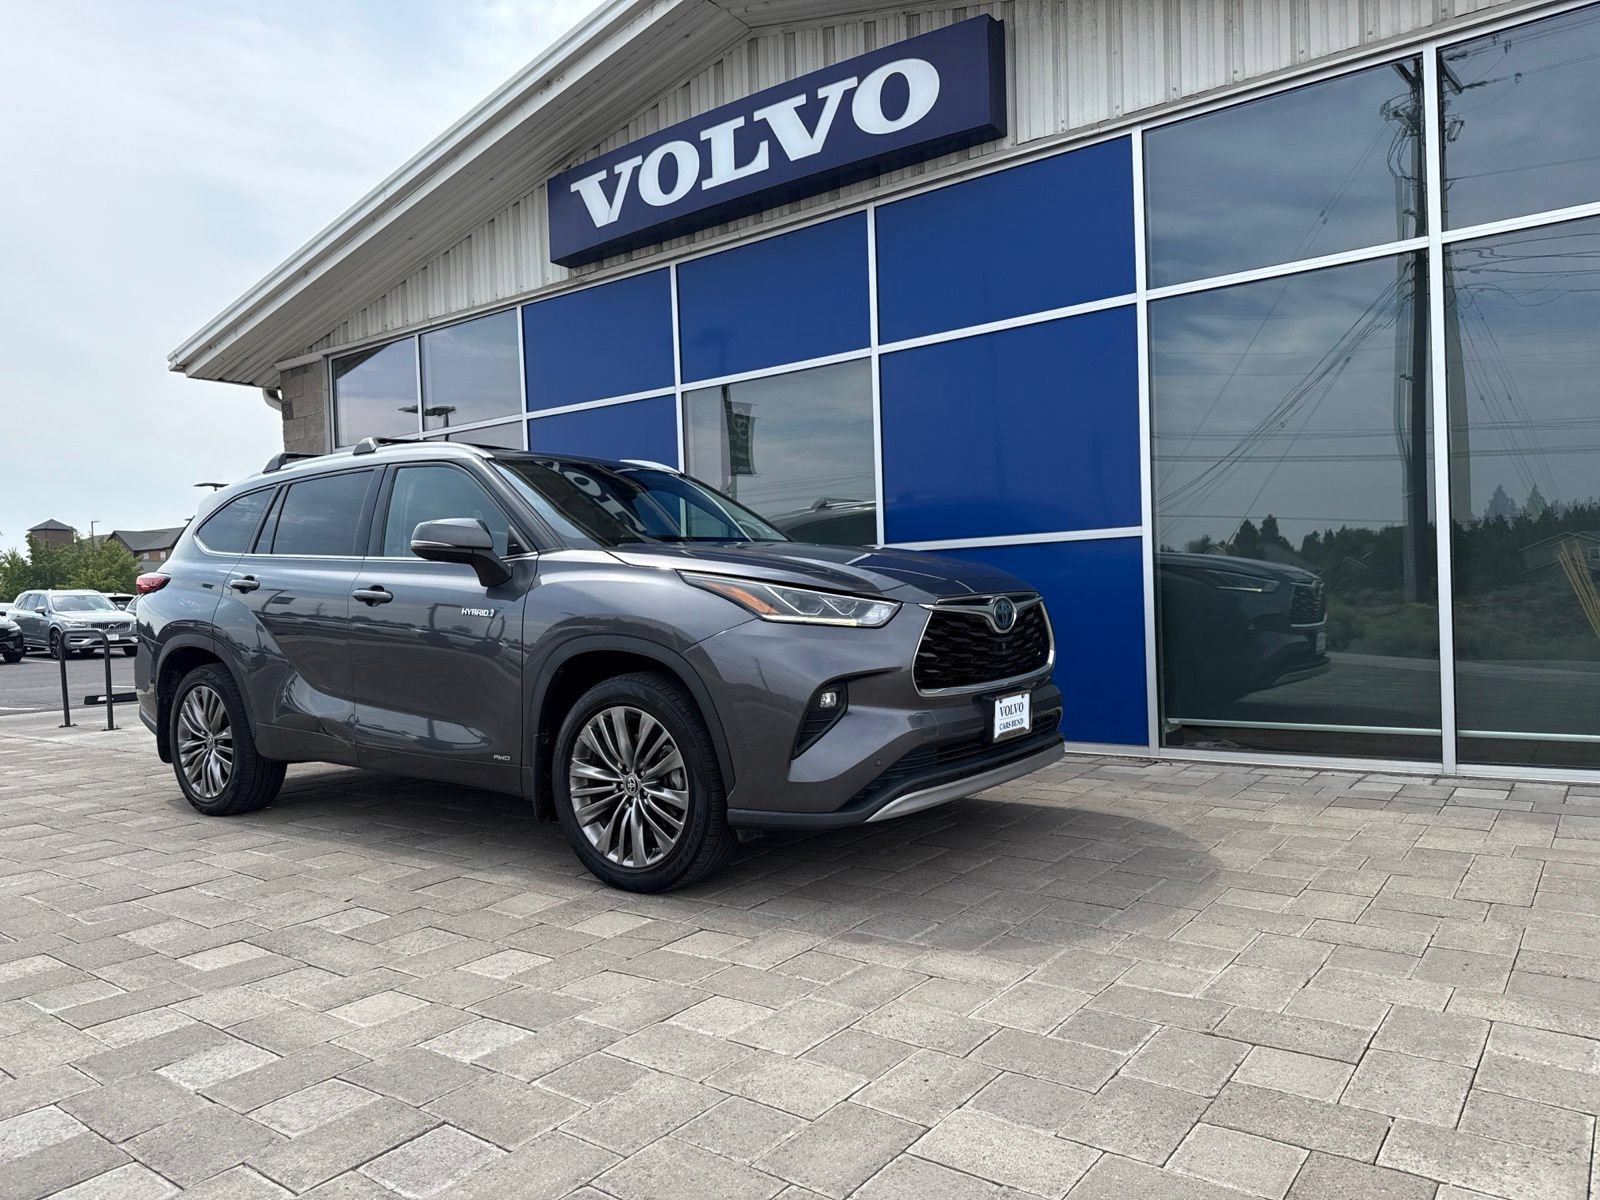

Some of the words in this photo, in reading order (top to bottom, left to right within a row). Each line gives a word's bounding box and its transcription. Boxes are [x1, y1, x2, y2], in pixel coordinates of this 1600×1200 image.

[571, 58, 941, 229] VOLVO
[461, 608, 489, 617] HYBRID
[999, 702, 1024, 717] VOLVO
[999, 722, 1011, 731] CARS
[1011, 718, 1024, 728] BEND
